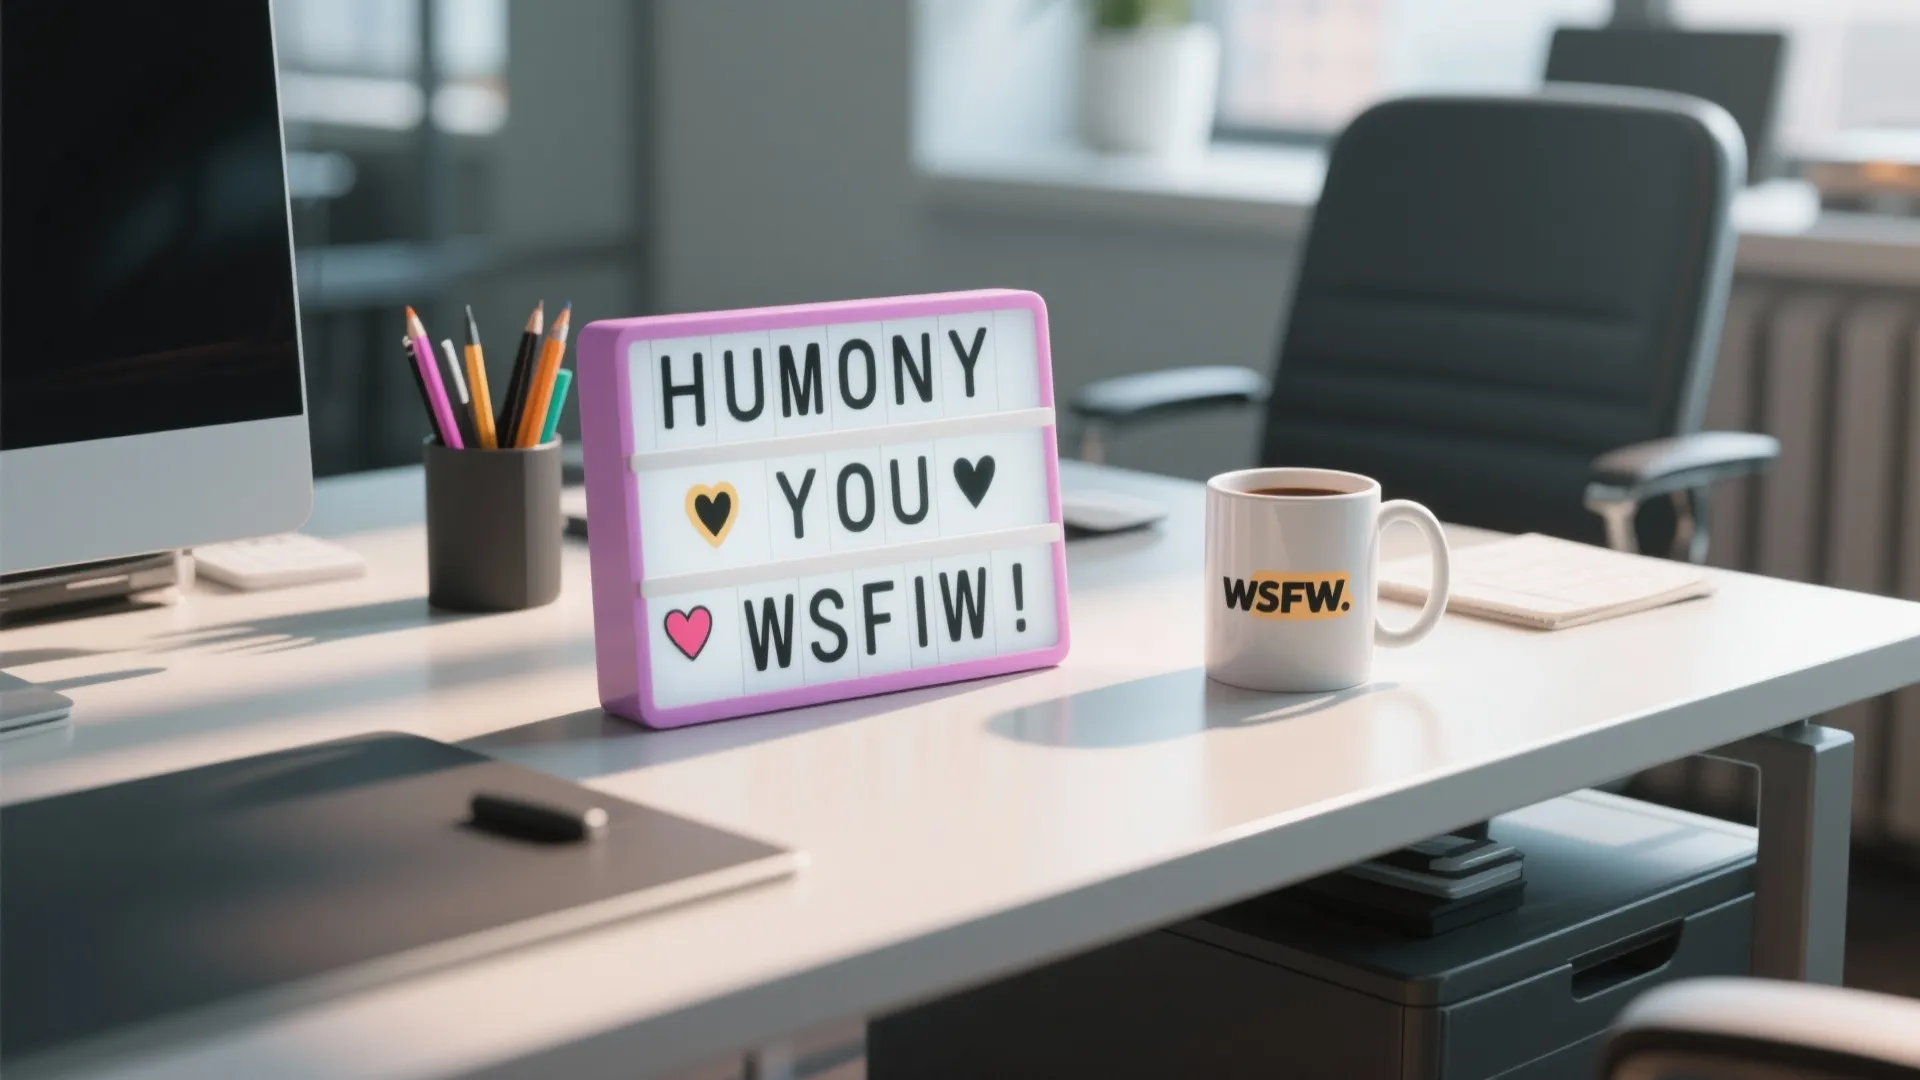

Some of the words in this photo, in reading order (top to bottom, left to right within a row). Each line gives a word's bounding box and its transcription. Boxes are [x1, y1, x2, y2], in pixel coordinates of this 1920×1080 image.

[660, 327, 988, 430] HUMONY
[776, 455, 930, 539] YOU
[1223, 576, 1350, 614] WSFW.
